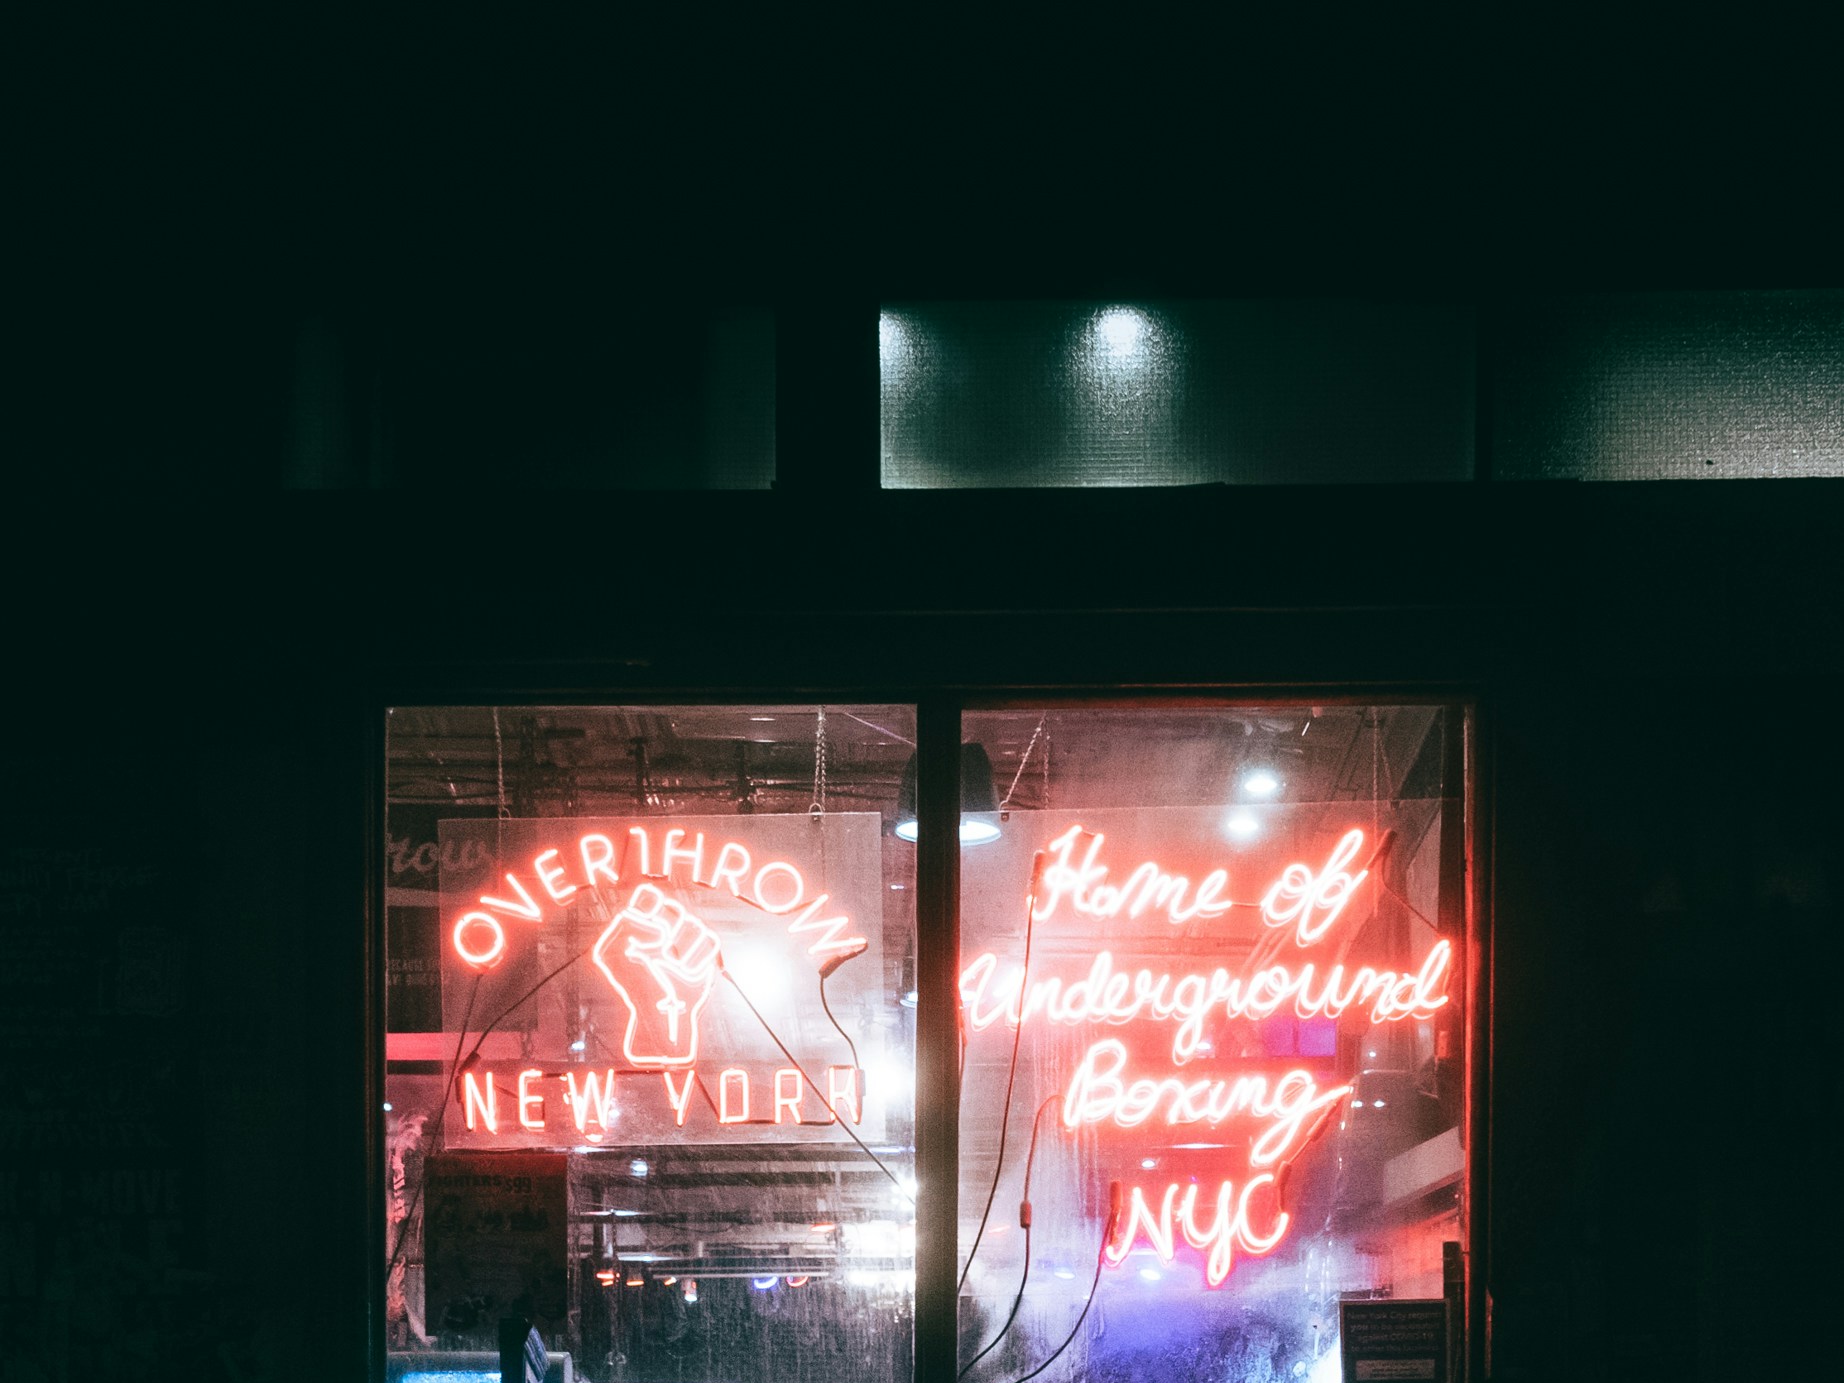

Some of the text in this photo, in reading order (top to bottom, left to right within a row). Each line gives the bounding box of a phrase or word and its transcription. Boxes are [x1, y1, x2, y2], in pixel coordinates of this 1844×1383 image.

[453, 827, 868, 964] OVERTHROW
[1033, 824, 1370, 946] Home of
[958, 939, 1452, 1066] Underground
[462, 1066, 863, 1134] NEW YORK
[1062, 1038, 1354, 1166] Boxing
[1106, 1173, 1290, 1286] NYC
